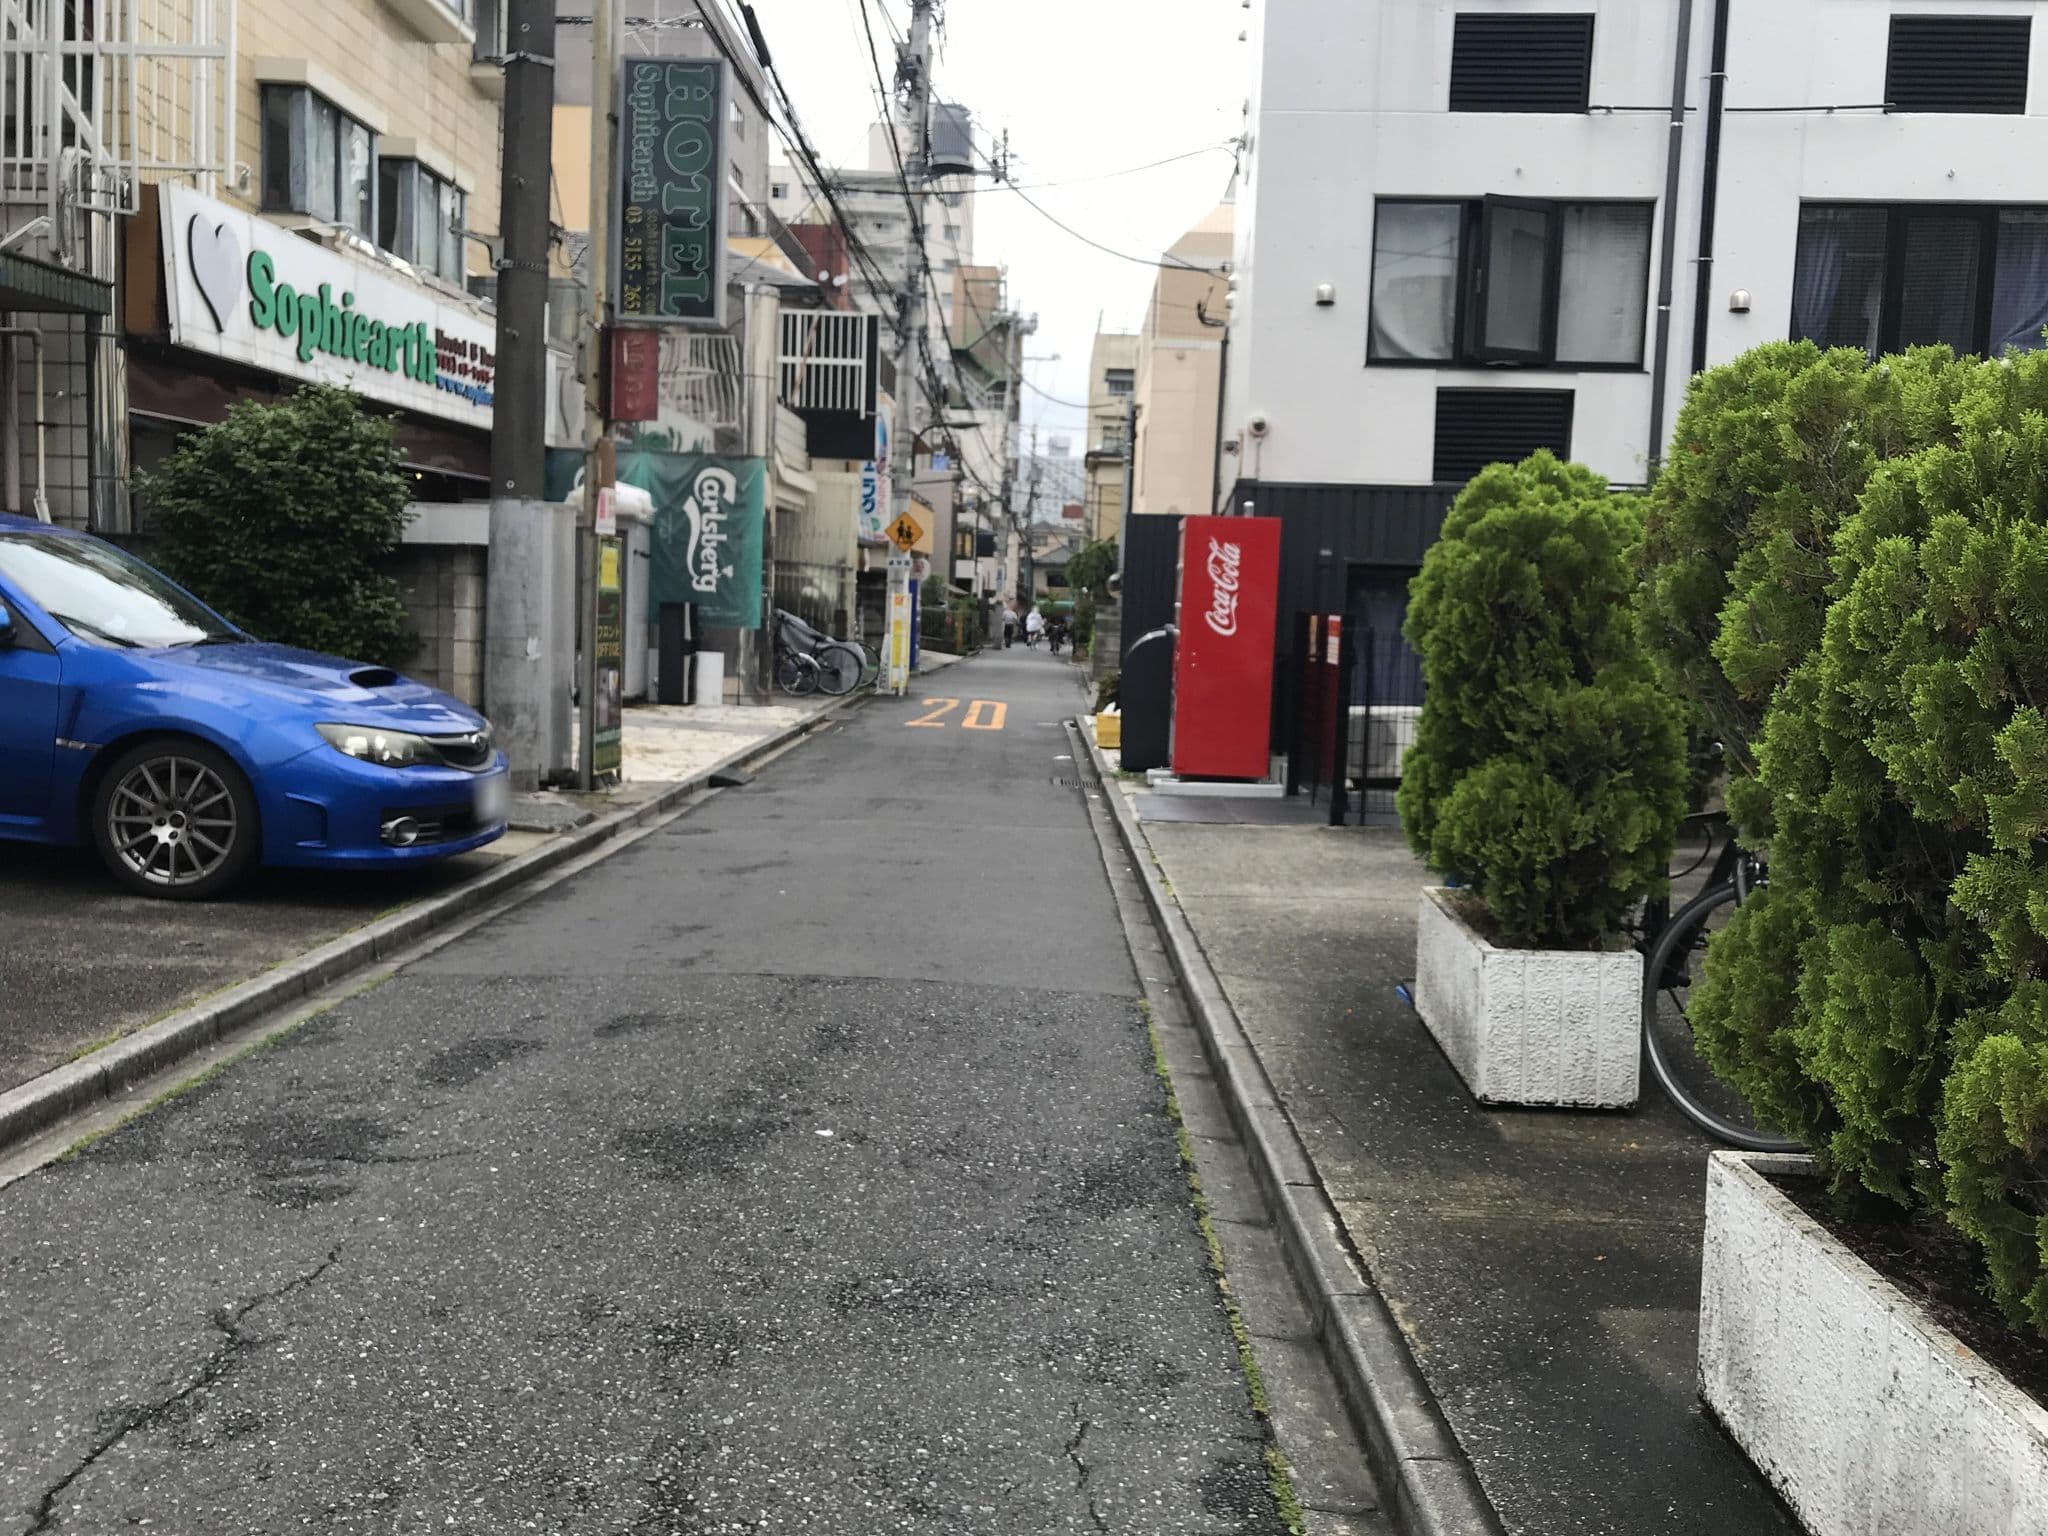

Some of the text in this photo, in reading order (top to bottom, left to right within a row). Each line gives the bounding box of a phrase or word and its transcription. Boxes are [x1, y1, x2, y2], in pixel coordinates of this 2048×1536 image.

[628, 64, 663, 203] Sophiearth
[661, 64, 715, 317] HOTEL
[247, 250, 437, 385] Sophiearth
[683, 466, 737, 593] Carlsberg
[1205, 536, 1241, 636] Coca-Cola
[904, 698, 1008, 730] 20
